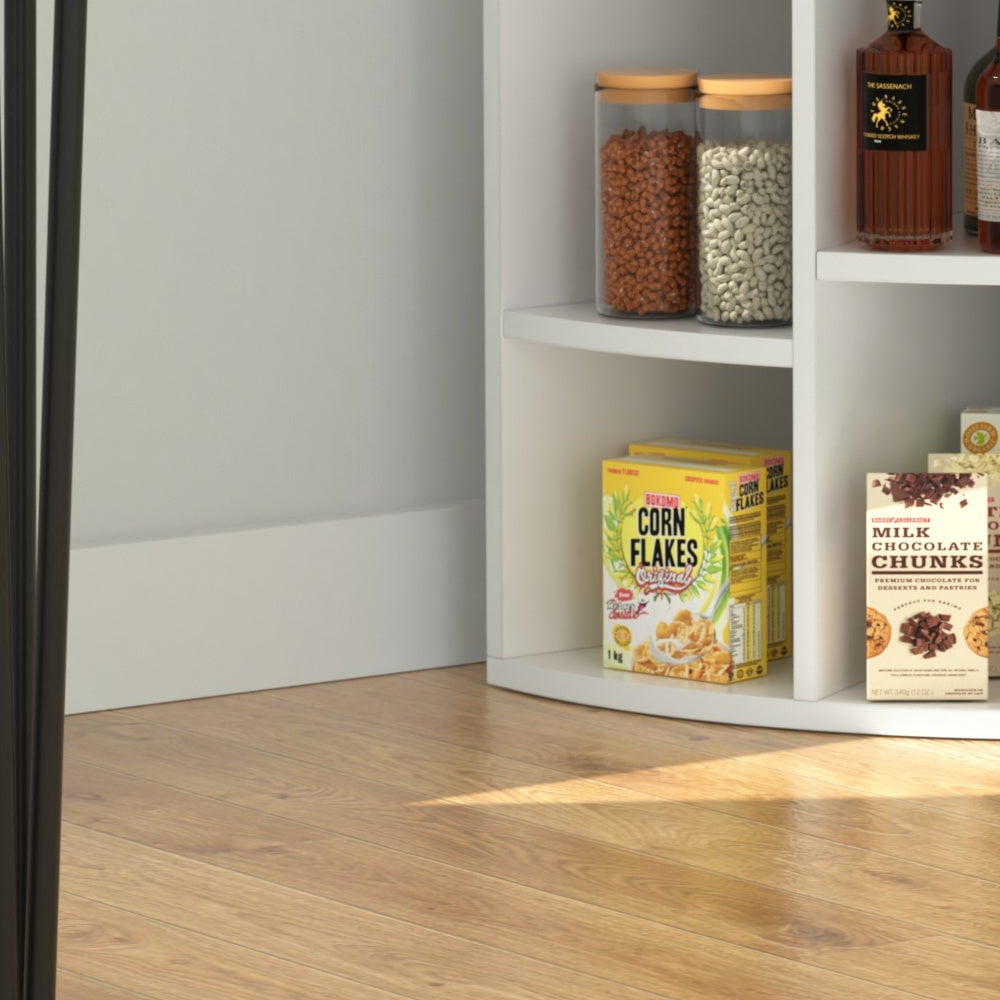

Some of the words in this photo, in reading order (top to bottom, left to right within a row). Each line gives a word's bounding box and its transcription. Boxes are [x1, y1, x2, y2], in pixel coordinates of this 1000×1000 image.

[876, 82, 913, 90] SASSENACH
[739, 480, 759, 497] CORN
[736, 491, 764, 512] FLAKES
[638, 507, 685, 536] CORN
[872, 527, 930, 538] MILK
[630, 538, 698, 568] FLAKES
[872, 542, 983, 551] CHOCOLATE
[871, 555, 983, 569] CHUNKS
[634, 563, 693, 593] Original
[613, 650, 623, 664] kg
